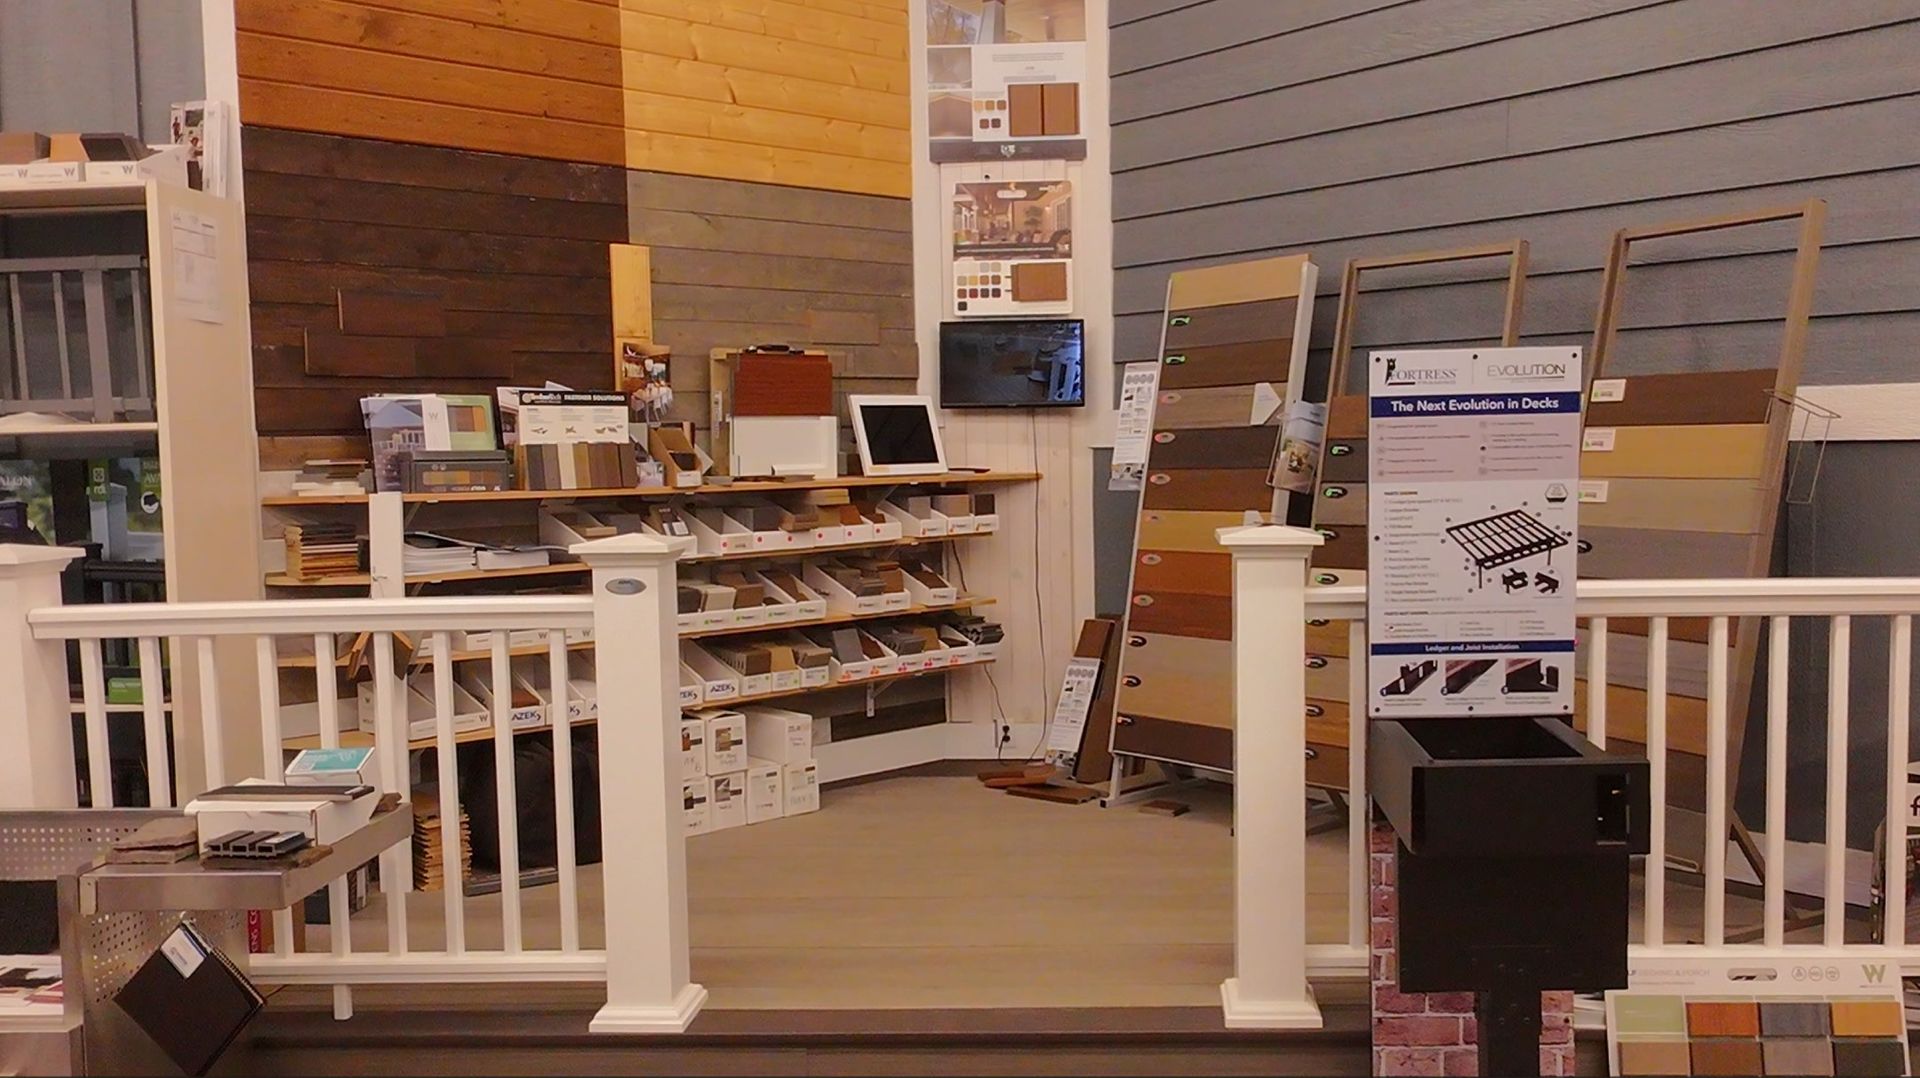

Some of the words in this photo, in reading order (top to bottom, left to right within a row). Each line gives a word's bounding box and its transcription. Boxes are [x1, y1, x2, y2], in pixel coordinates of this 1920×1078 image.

[1389, 367, 1457, 380] FORTRESS
[1487, 363, 1566, 377] EVOLUTION
[1391, 400, 1414, 413] The
[1416, 399, 1446, 412] Next
[1448, 398, 1505, 411] Evolution
[1507, 397, 1519, 409] in
[1521, 396, 1559, 409] Decks
[1425, 644, 1449, 653] Ledger
[1450, 644, 1464, 652] and
[1465, 643, 1481, 652] Joist
[1482, 643, 1520, 651] Installation
[710, 683, 731, 694] AZEK
[511, 711, 537, 721] AZEK
[1861, 963, 1887, 984] W
